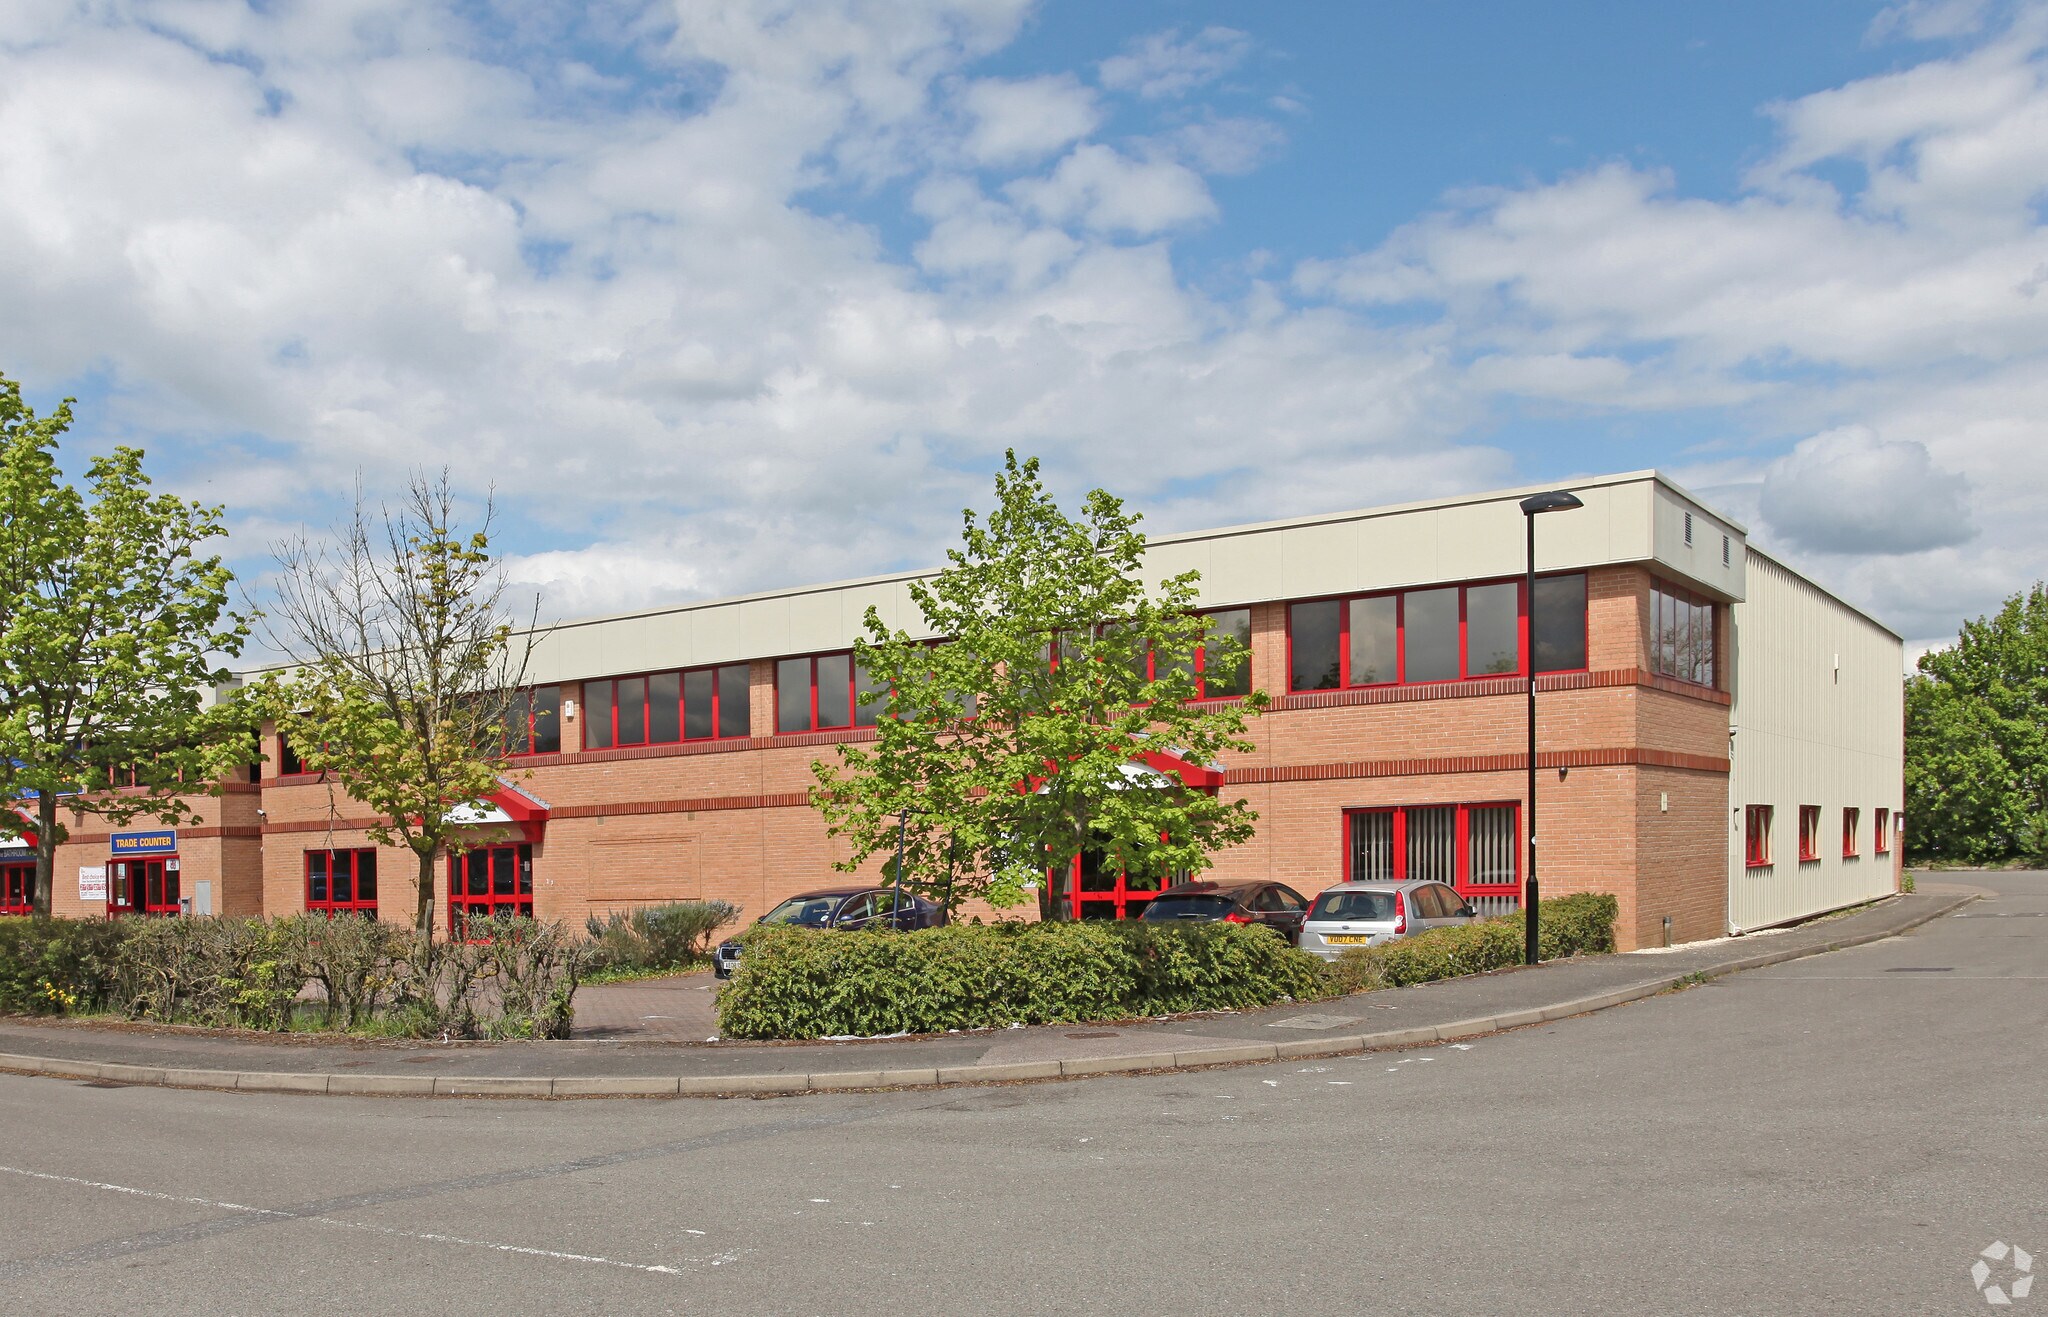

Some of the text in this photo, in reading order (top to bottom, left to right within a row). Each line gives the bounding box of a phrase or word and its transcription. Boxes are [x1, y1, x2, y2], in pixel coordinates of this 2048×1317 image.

[116, 837, 171, 848] TRADE COUNTER
[1349, 935, 1363, 943] CNE
